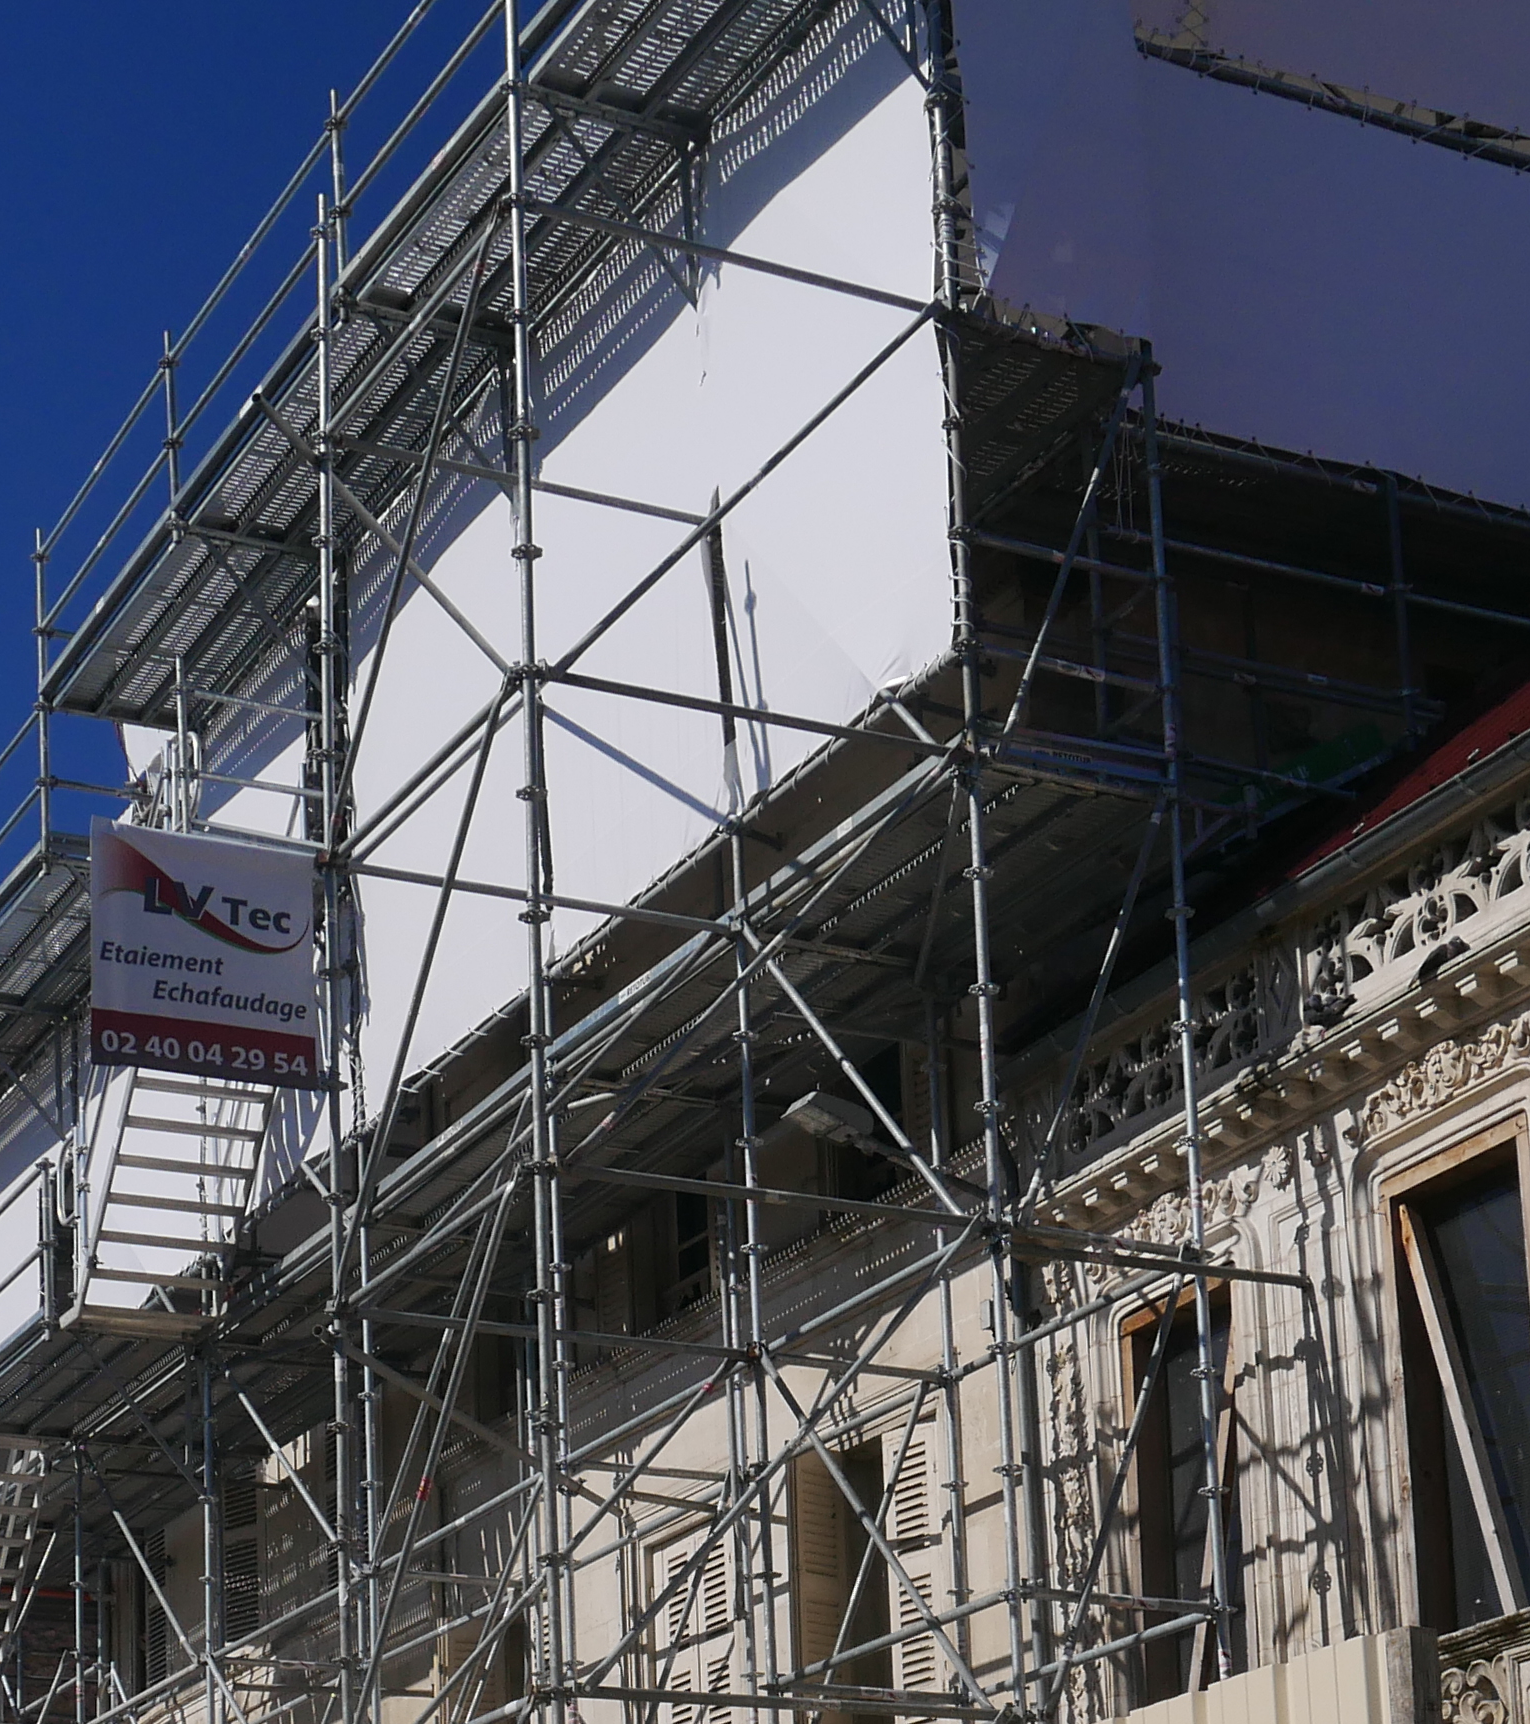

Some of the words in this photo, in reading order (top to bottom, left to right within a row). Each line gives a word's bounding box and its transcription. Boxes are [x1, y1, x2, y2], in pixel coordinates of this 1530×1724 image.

[143, 876, 214, 920] LV
[222, 896, 290, 934] Tec
[99, 941, 223, 975] Etaiement
[153, 980, 307, 1022] Echafaudage
[101, 1030, 137, 1055] 02
[145, 1036, 180, 1060] 40
[188, 1041, 223, 1066] 04
[231, 1046, 265, 1071] 29
[274, 1052, 308, 1077] 54
